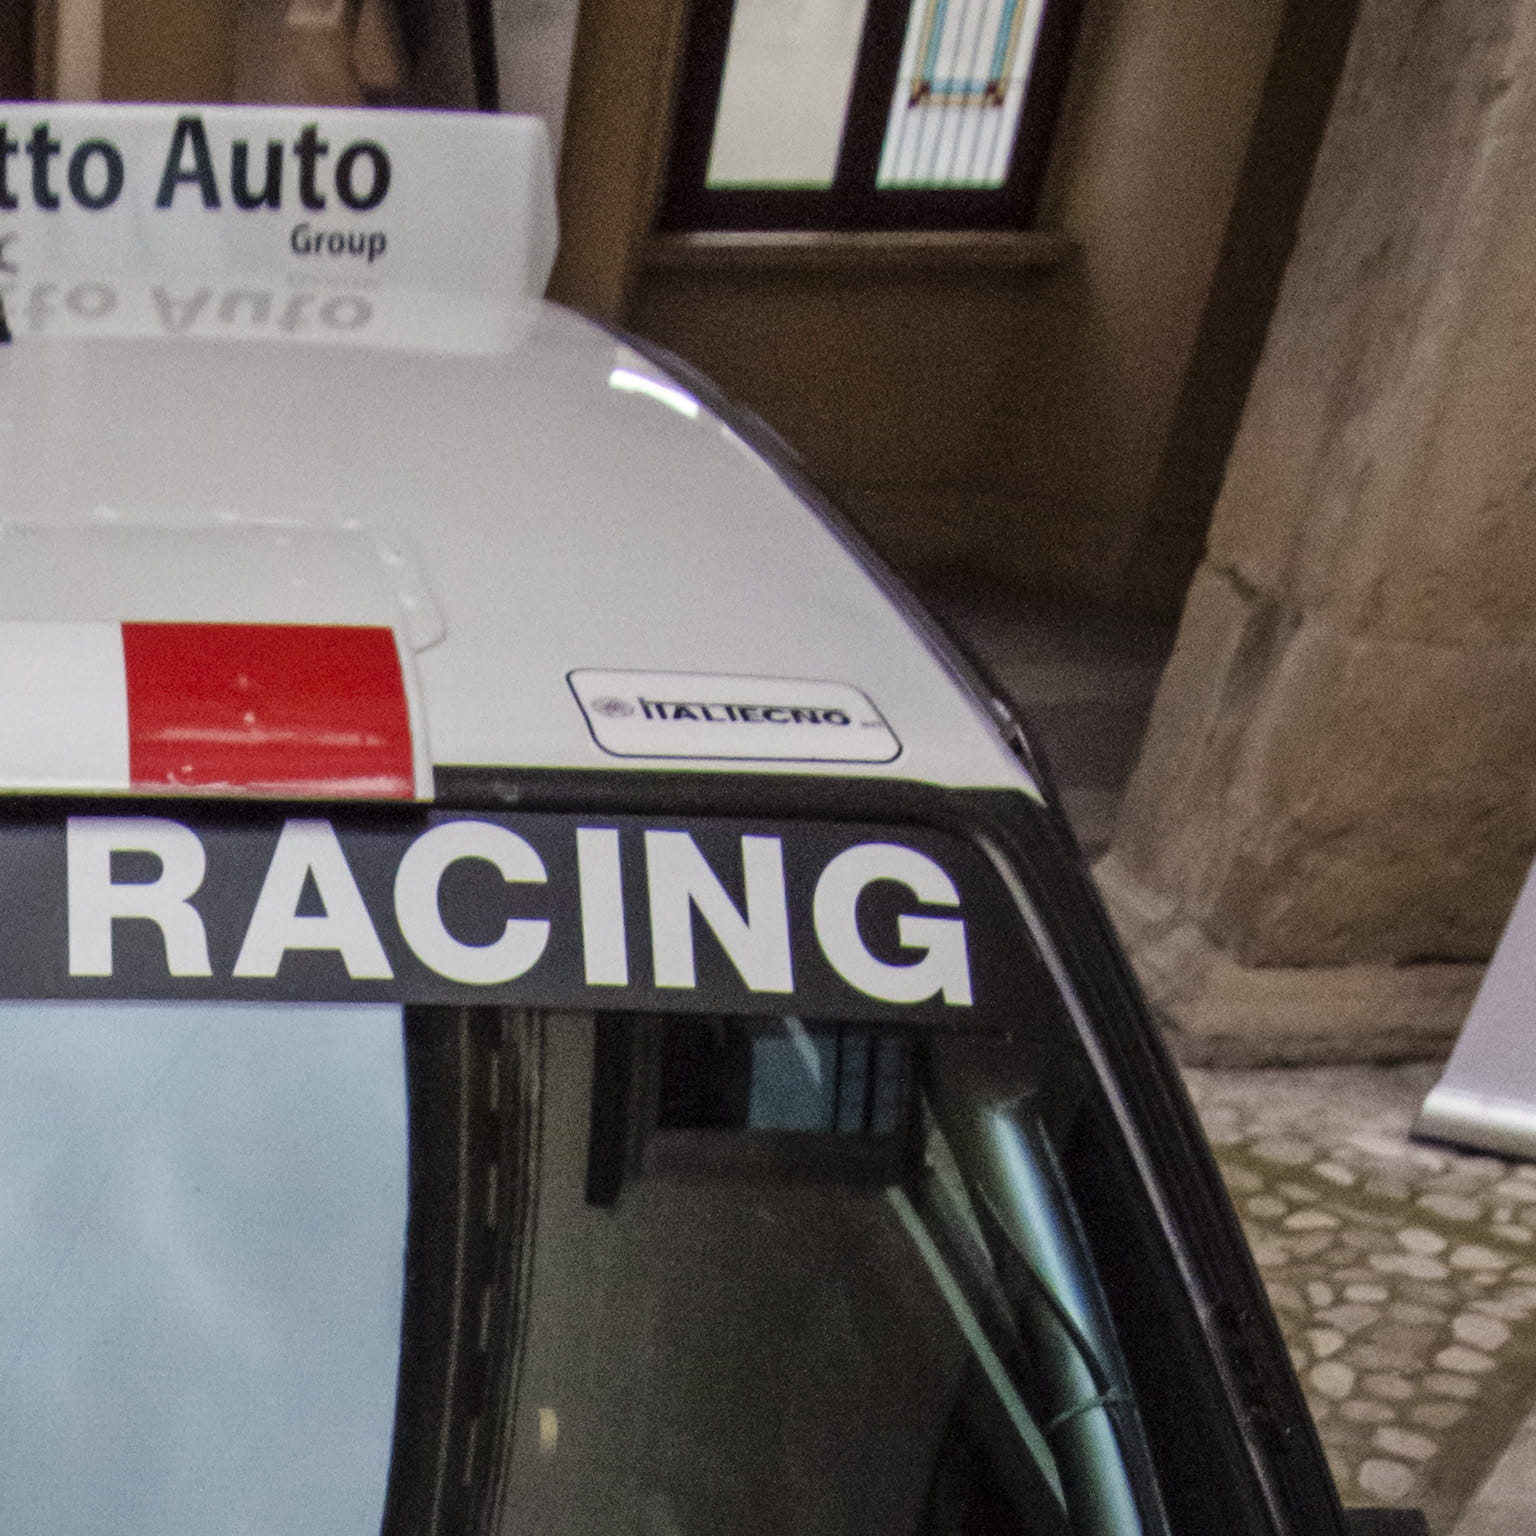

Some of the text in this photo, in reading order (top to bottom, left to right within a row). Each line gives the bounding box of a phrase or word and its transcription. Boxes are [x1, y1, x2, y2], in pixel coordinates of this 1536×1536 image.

[154, 115, 392, 212] Auto
[290, 223, 387, 262] Group
[637, 696, 852, 727] ITALTECNO
[66, 815, 974, 1007] RACING
